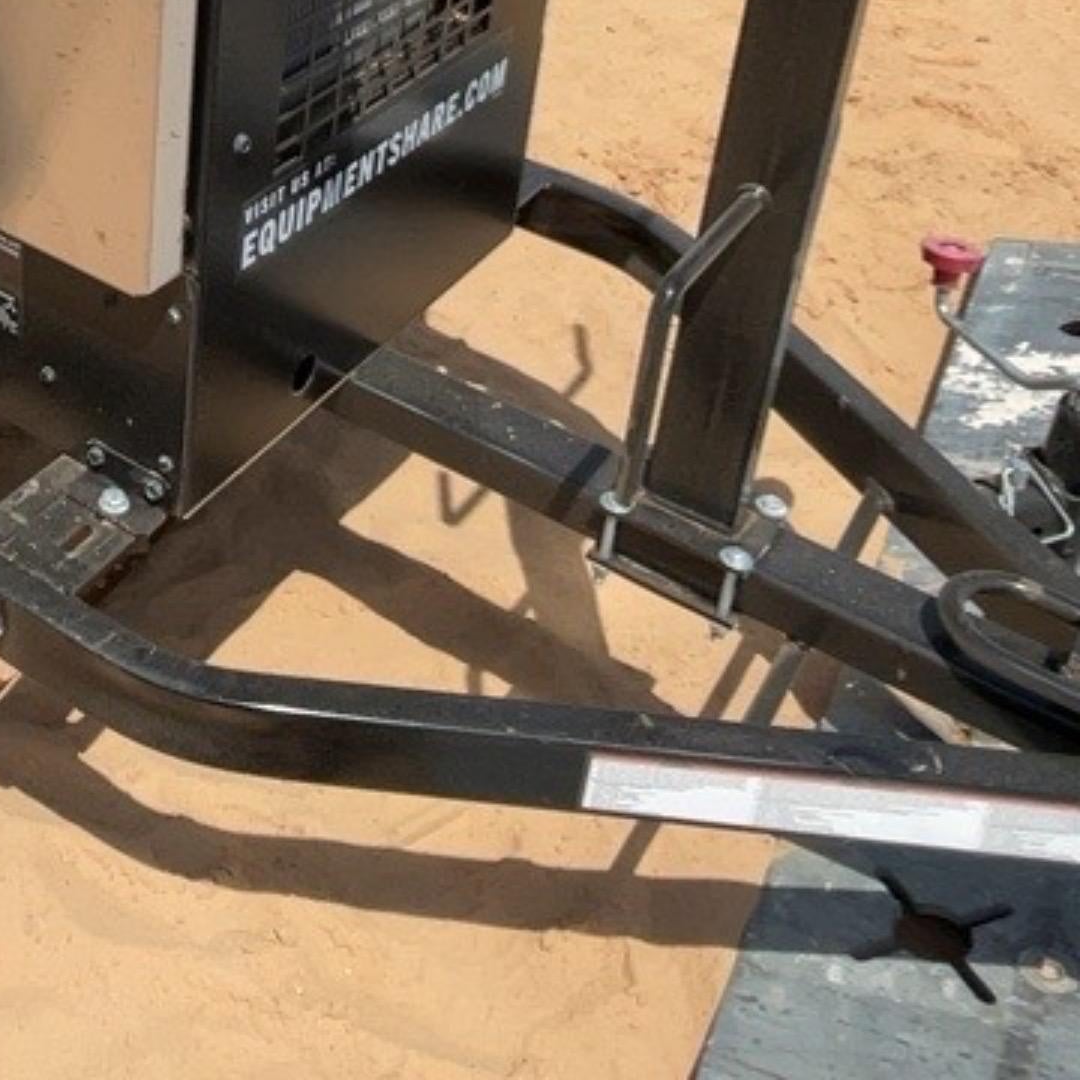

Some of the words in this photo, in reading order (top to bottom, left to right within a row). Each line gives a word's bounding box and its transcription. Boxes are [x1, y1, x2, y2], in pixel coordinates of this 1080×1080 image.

[240, 56, 509, 271] EQUIPMENTSHARE.COM
[244, 186, 285, 224] VISIT
[290, 170, 310, 194] US
